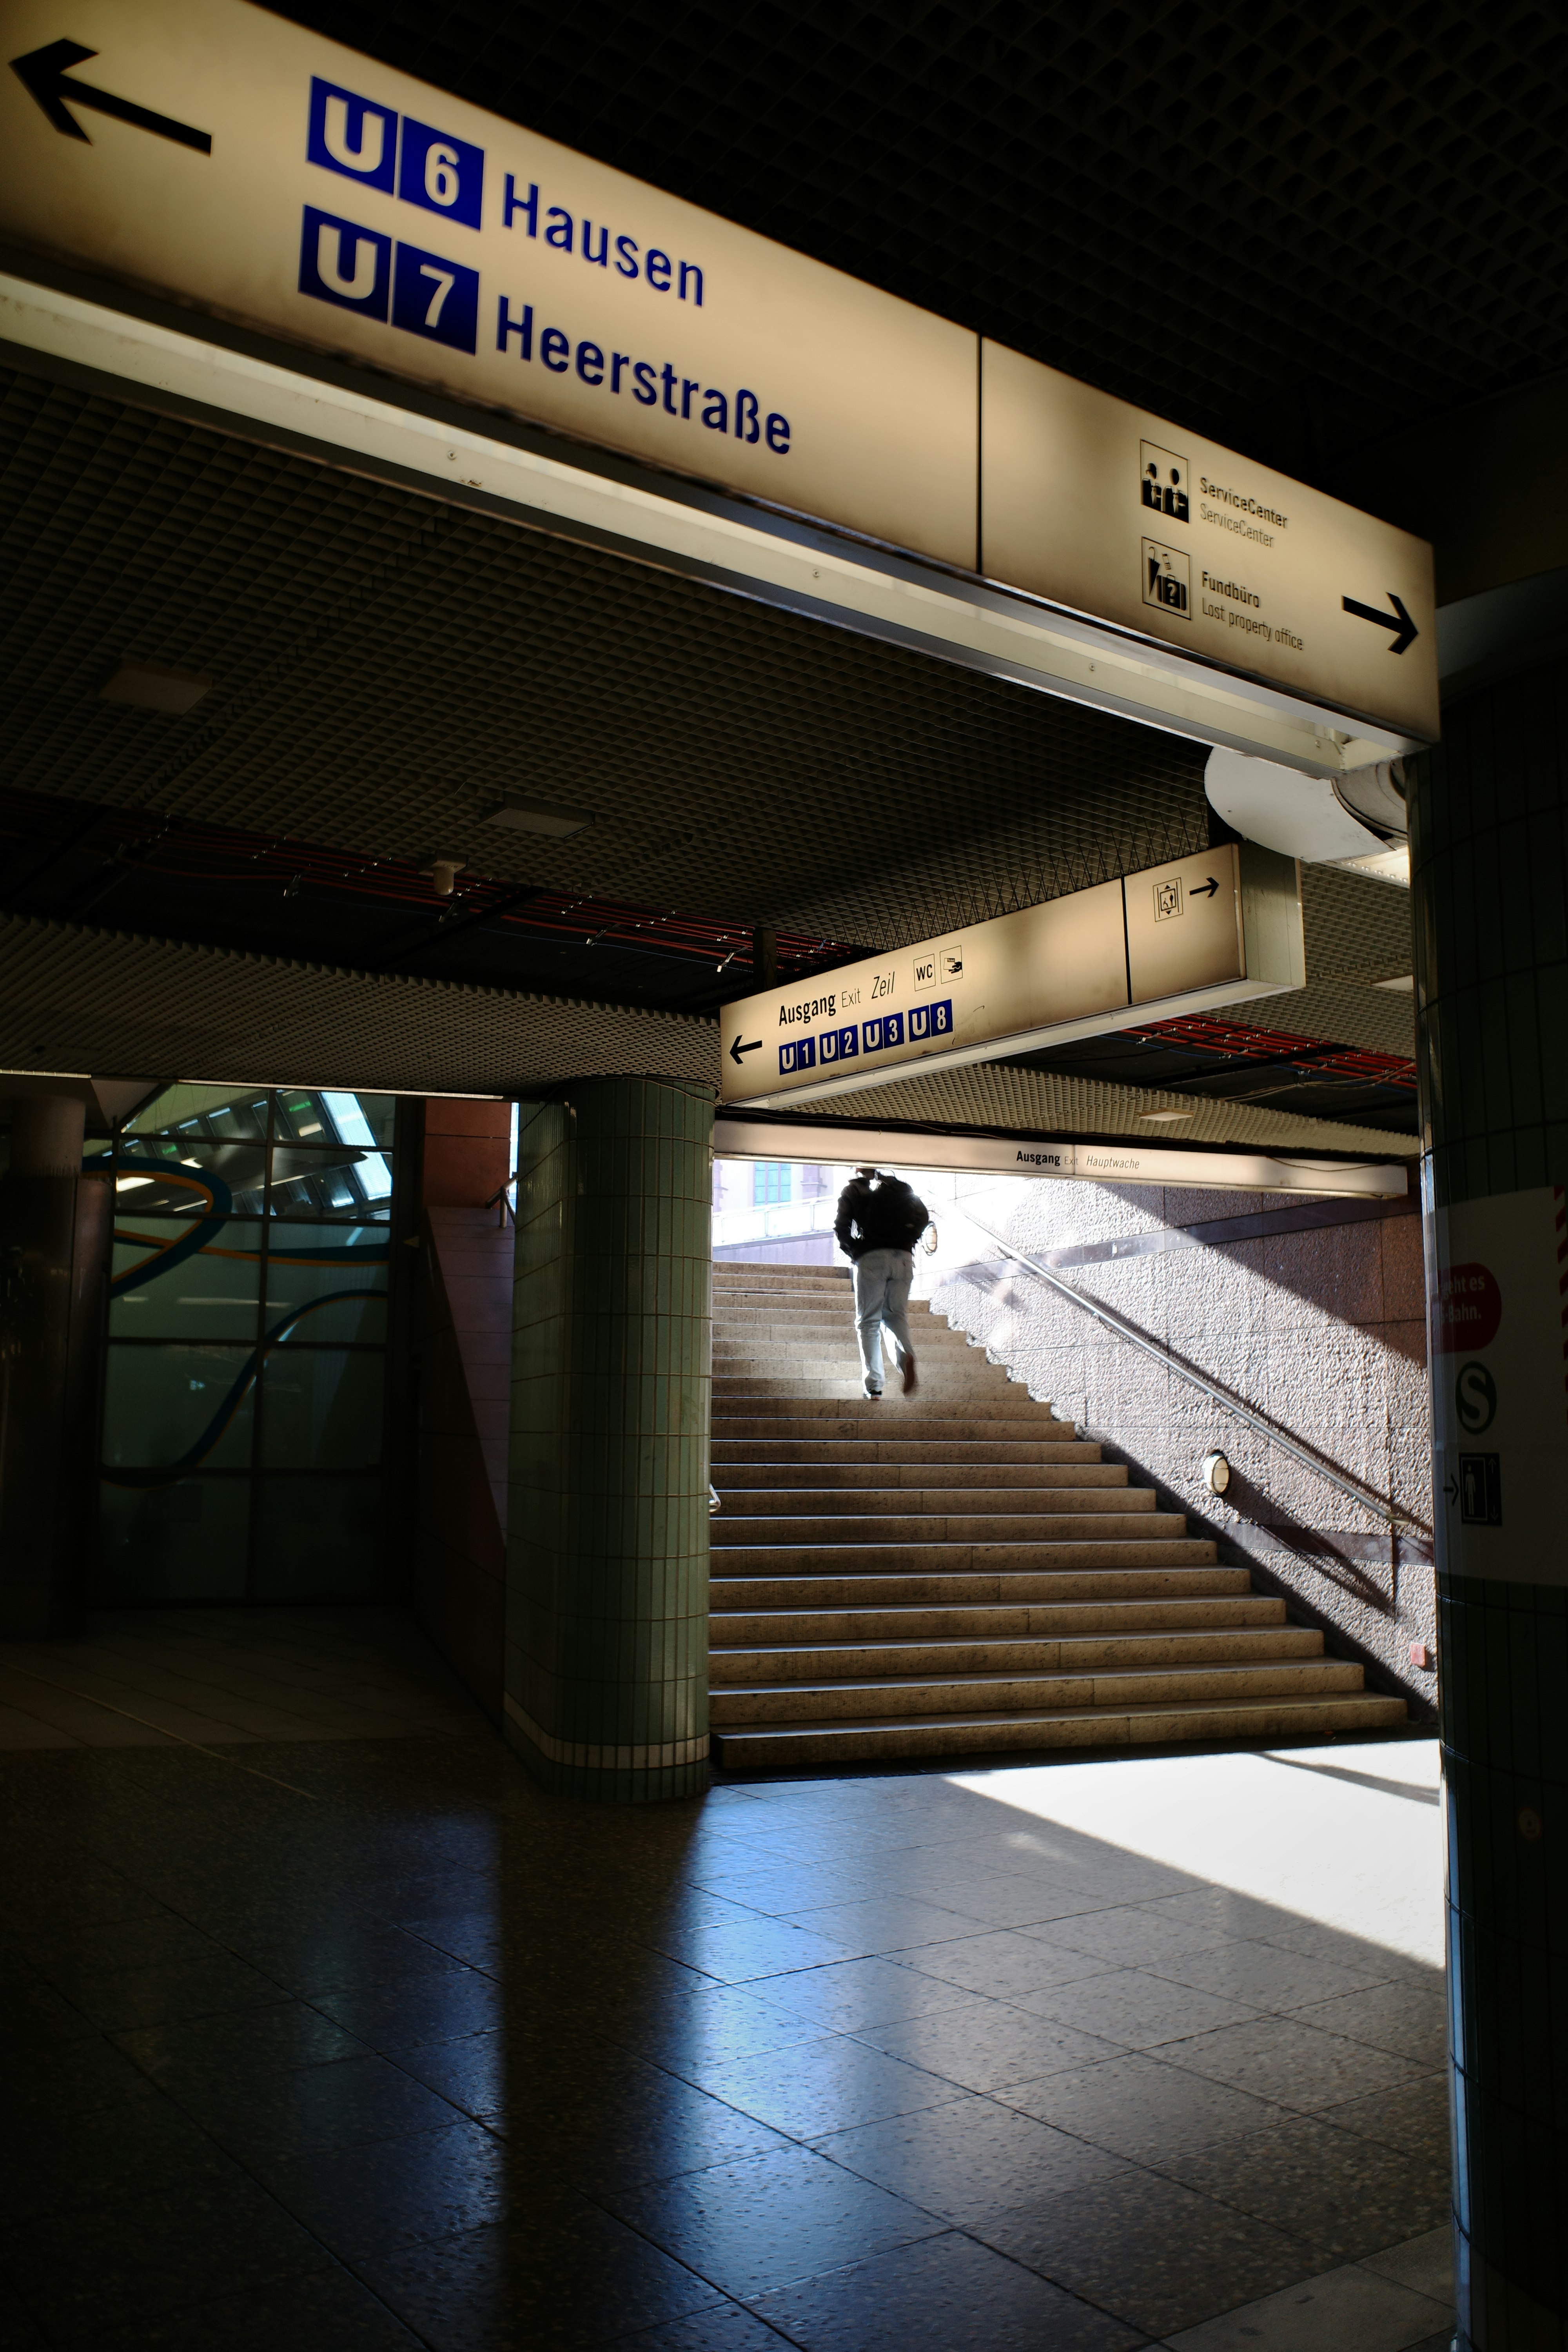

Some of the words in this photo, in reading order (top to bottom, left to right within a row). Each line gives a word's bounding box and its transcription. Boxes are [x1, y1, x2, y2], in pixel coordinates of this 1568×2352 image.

[503, 174, 703, 306] Hausen
[497, 295, 790, 454] Heerstraße
[1200, 477, 1287, 528] ServiceCenter
[1200, 504, 1273, 548] ServiceCenter
[1201, 571, 1259, 608] Fundbüro
[1202, 597, 1225, 622] Lost
[1229, 611, 1271, 642] property
[1275, 629, 1303, 650] office
[916, 964, 933, 981] WC
[779, 995, 836, 1026] Ausgang
[842, 988, 860, 1007] Exit
[871, 971, 895, 999] Zeil
[1016, 1151, 1060, 1166] Ausgang
[1064, 1156, 1078, 1165] Exit
[1087, 1155, 1140, 1169] Hauptwache
[1469, 1276, 1485, 1291] es
